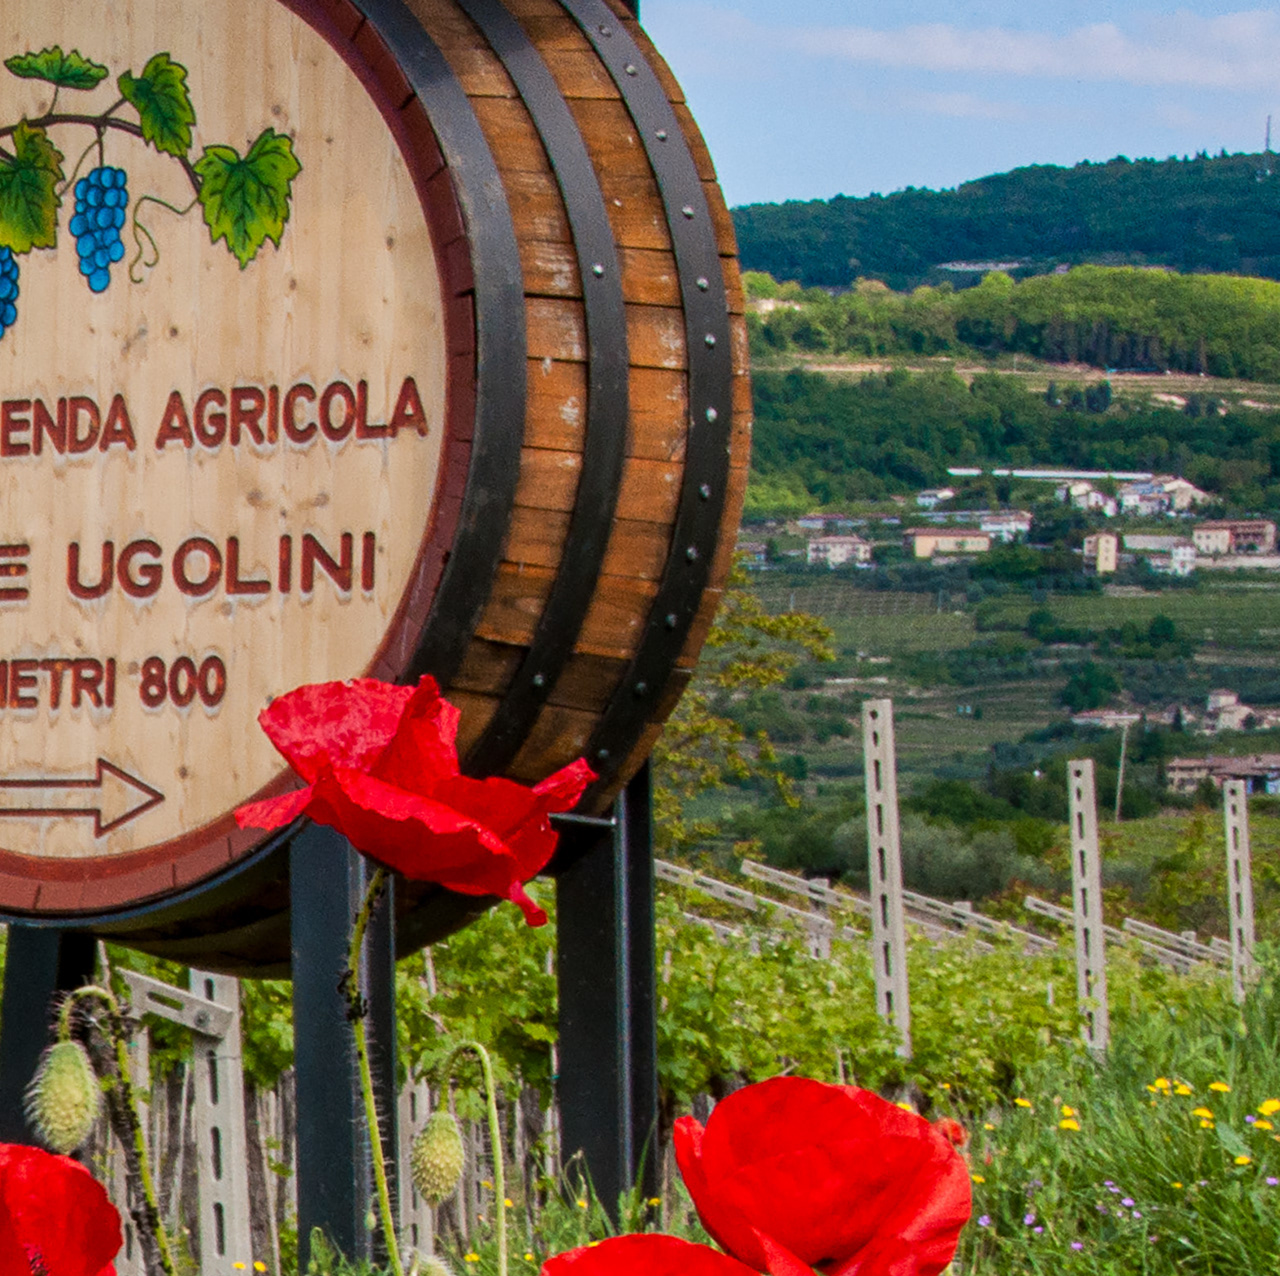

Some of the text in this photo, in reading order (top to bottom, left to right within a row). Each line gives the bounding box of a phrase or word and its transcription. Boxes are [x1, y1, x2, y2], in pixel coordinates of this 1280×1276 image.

[155, 376, 428, 450] AGRICOLA
[67, 531, 376, 599] UGOLINI
[139, 655, 228, 707] 800
